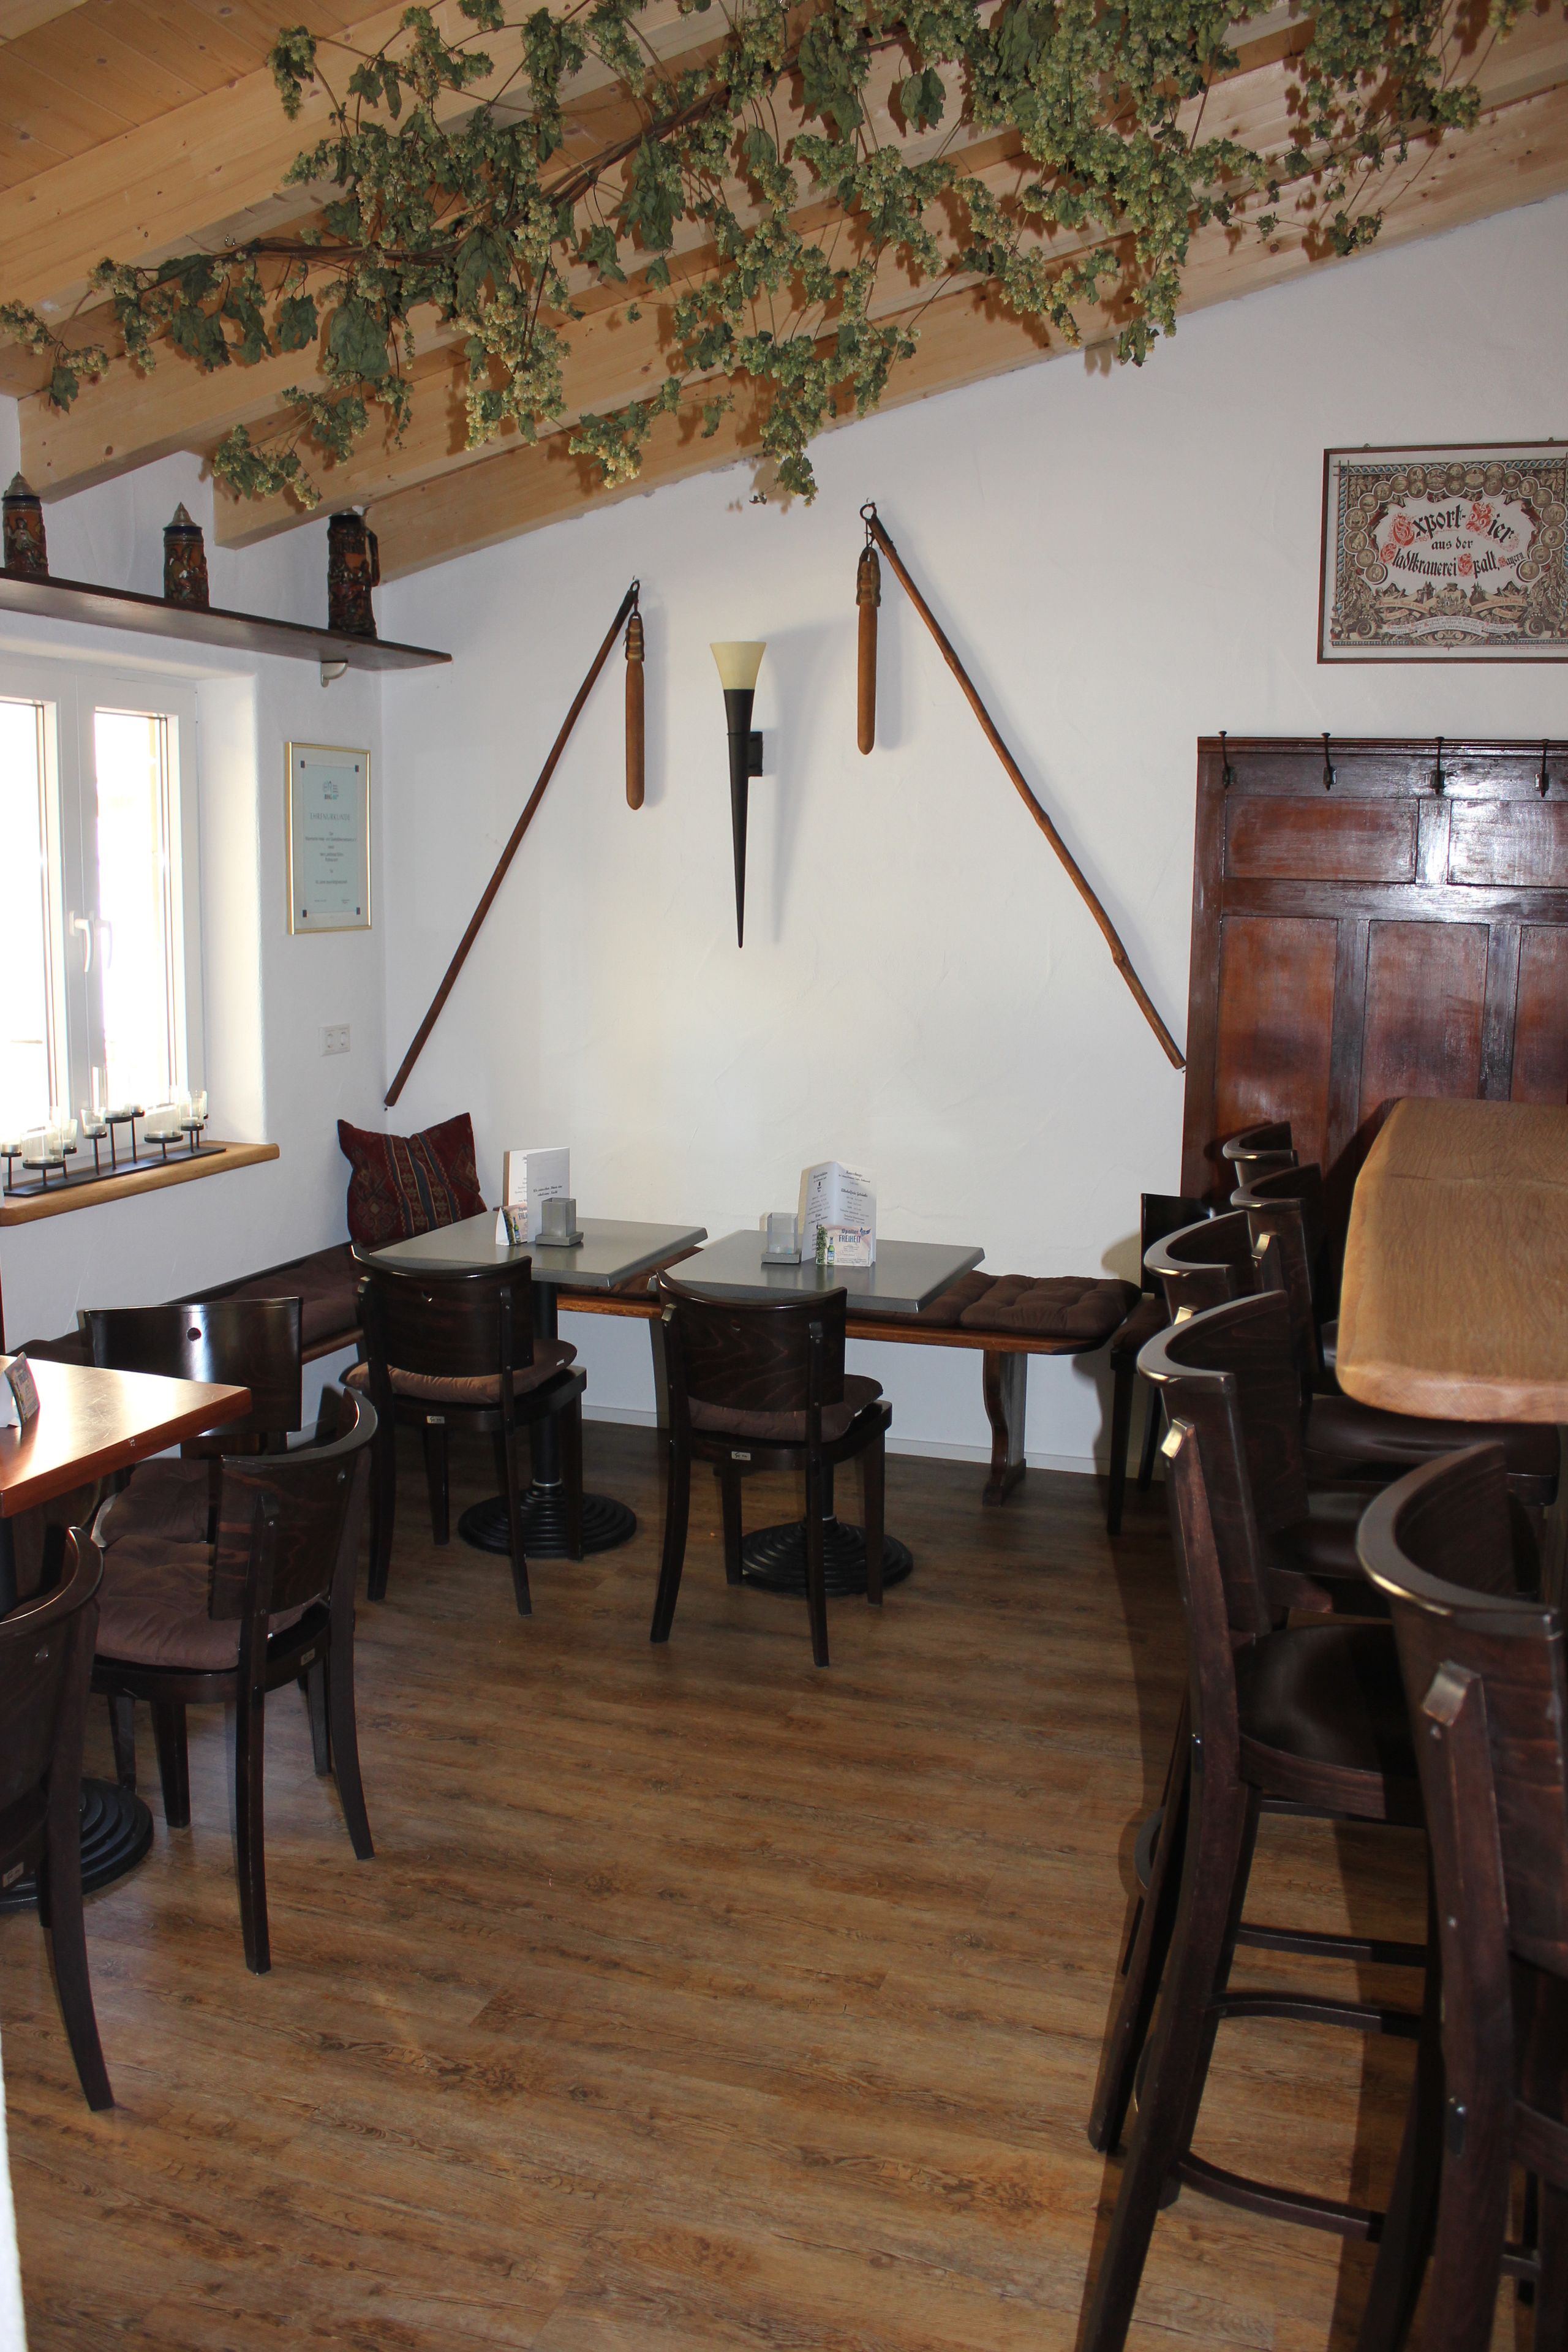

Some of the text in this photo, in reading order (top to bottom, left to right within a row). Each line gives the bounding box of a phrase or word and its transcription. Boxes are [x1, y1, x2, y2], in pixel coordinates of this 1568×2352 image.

[1431, 536, 1473, 550] aus der
[1380, 543, 1457, 577] Stadtbrauerei
